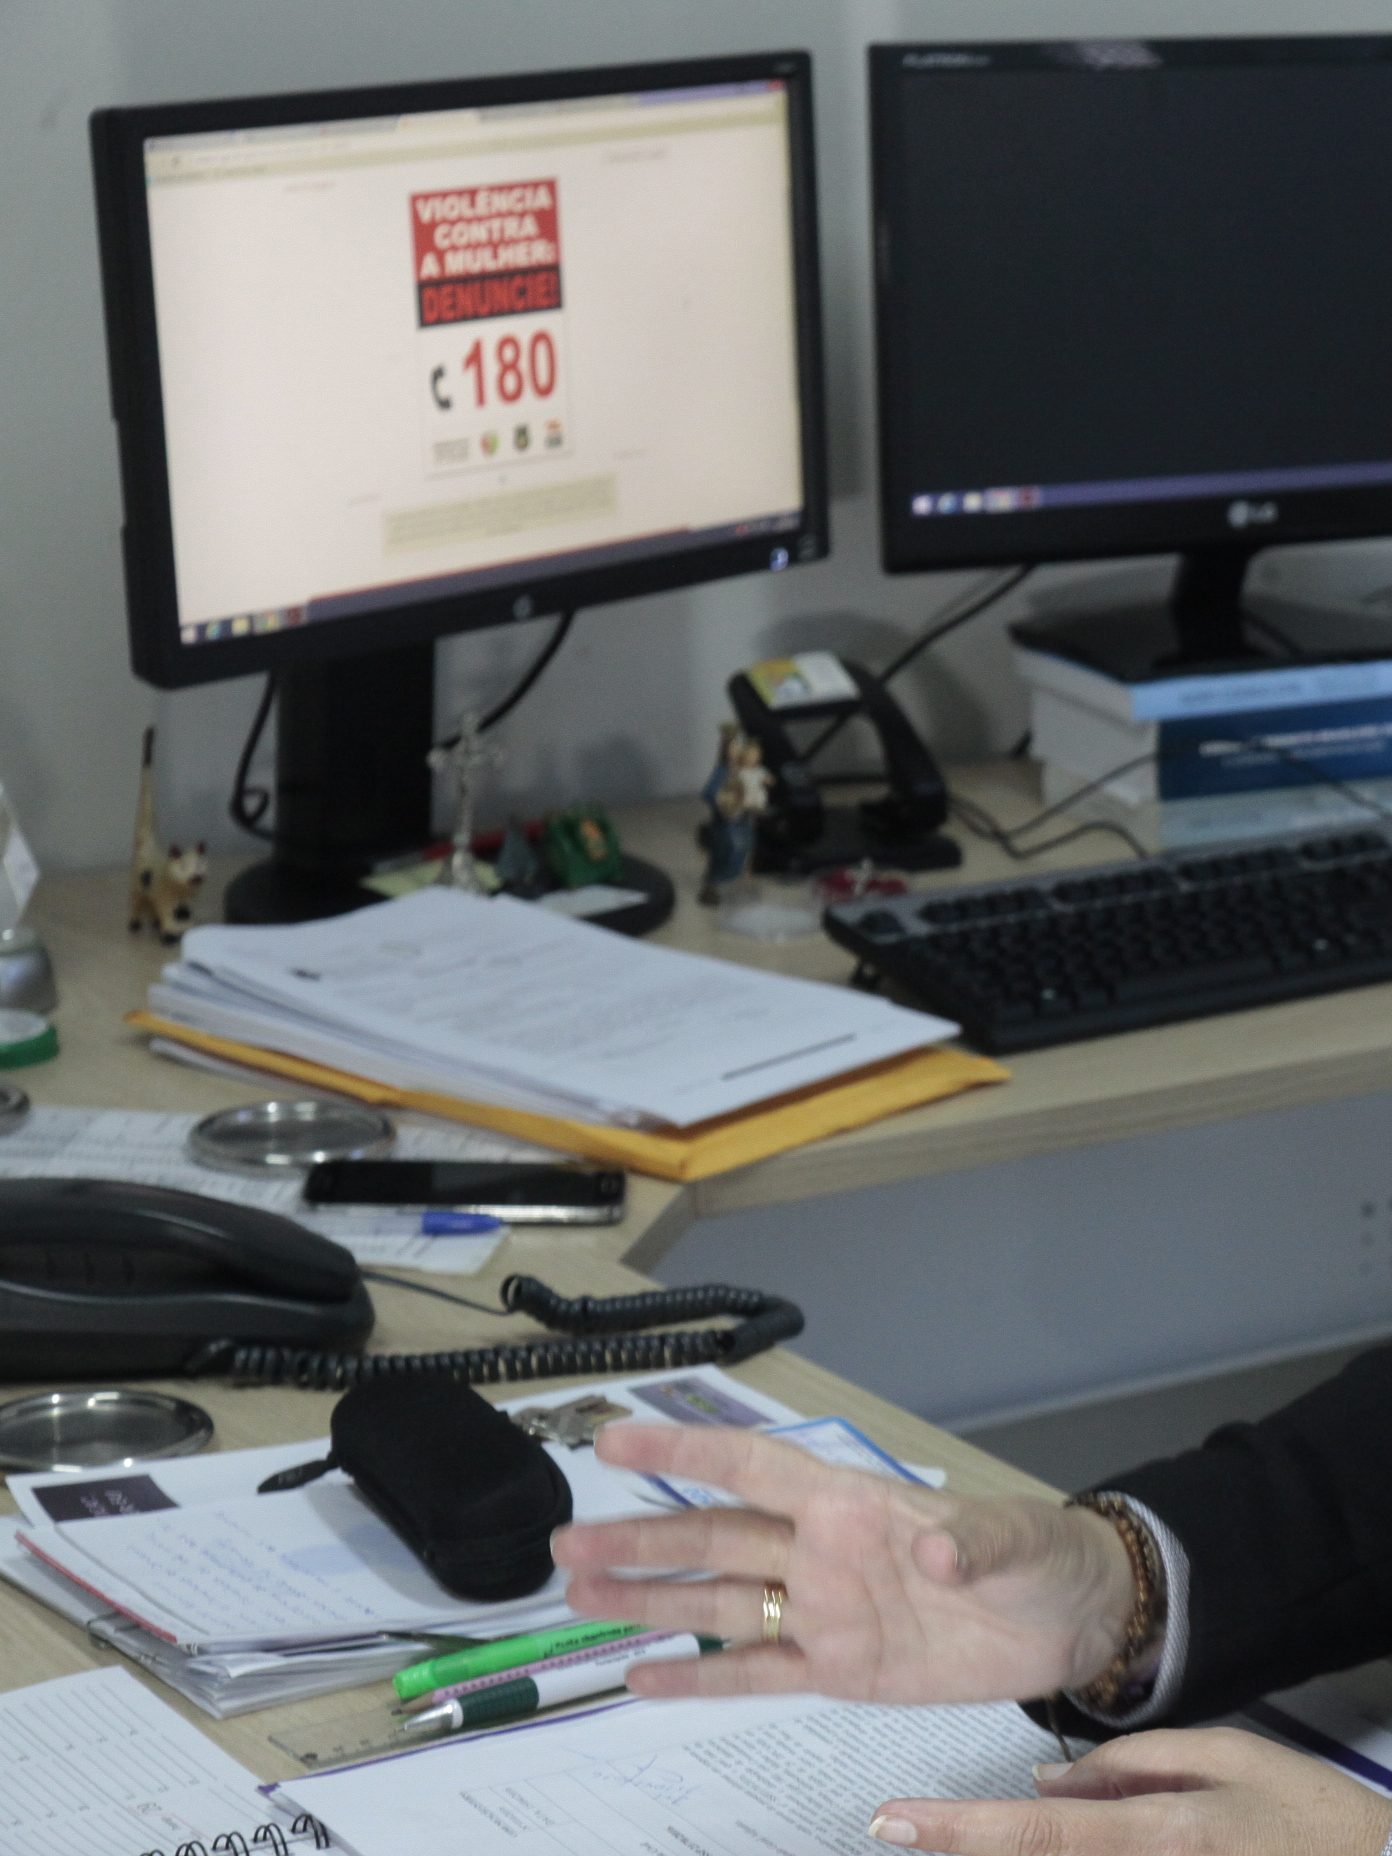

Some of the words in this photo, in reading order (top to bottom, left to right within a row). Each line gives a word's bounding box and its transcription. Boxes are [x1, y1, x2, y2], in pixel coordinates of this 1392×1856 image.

[433, 213, 539, 250] CONTRA
[419, 251, 442, 280] A
[463, 329, 557, 408] 180
